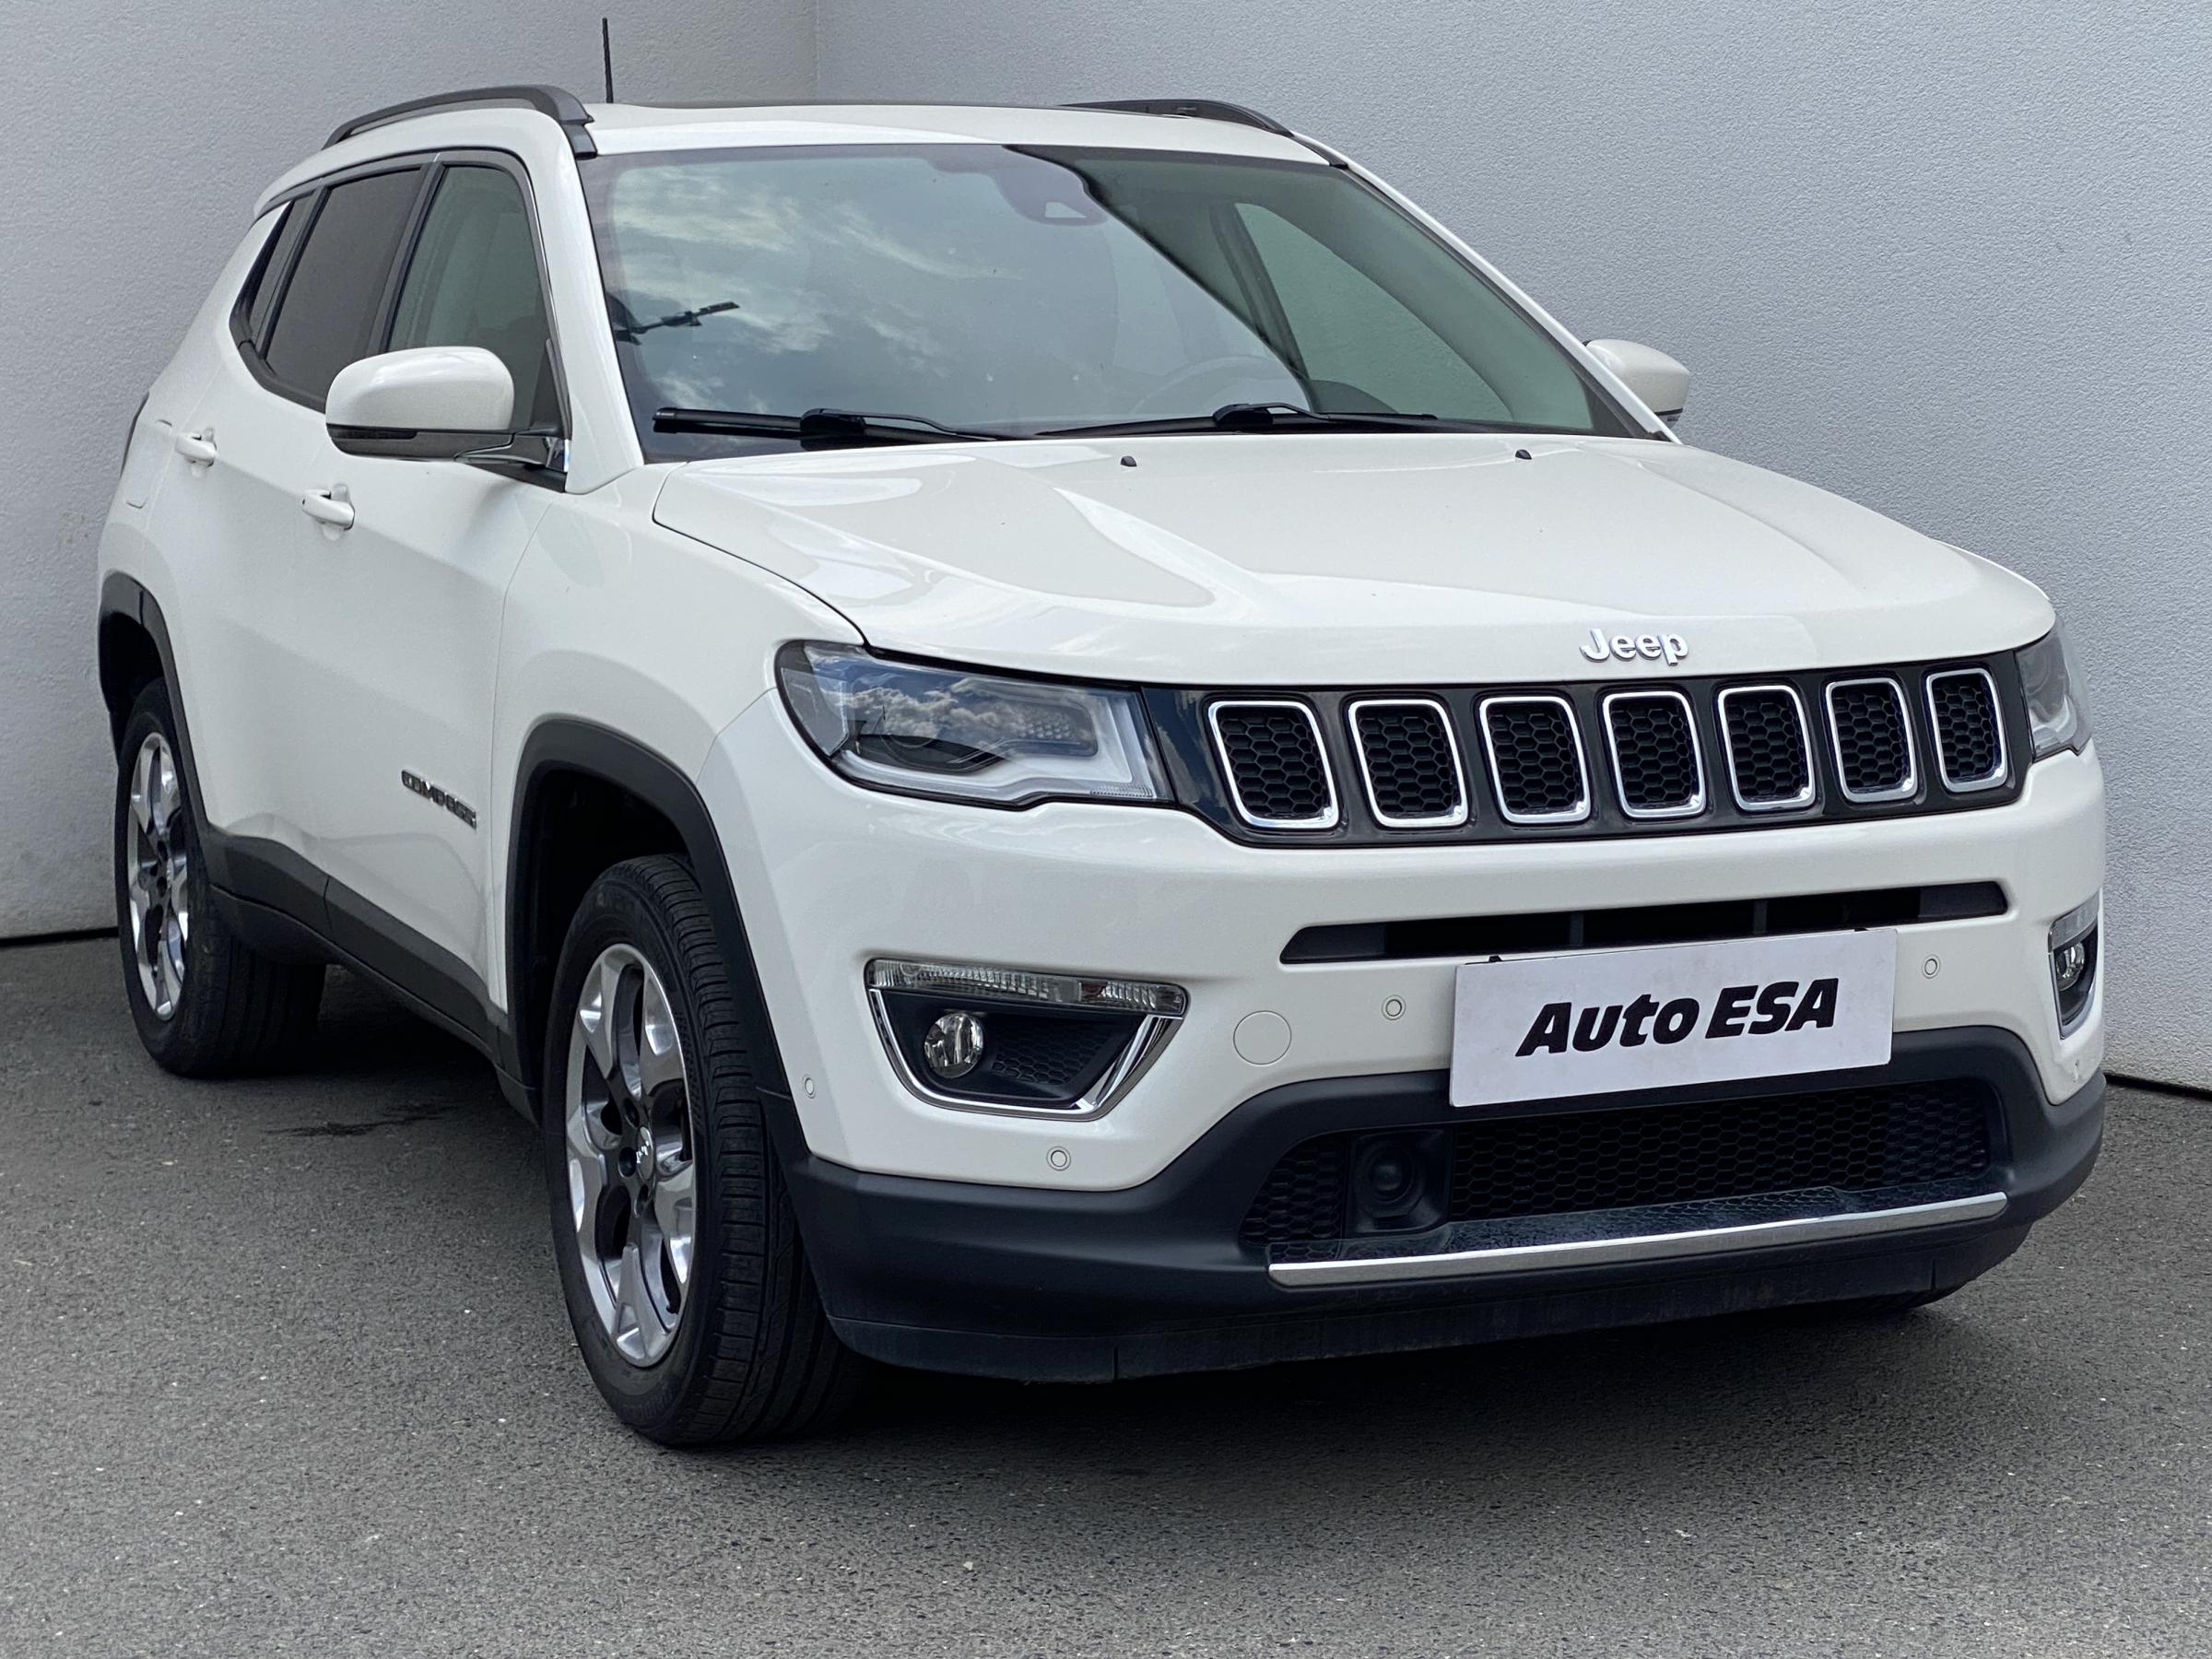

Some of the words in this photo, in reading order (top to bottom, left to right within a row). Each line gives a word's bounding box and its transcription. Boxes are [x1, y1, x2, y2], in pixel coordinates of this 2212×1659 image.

[1580, 629, 1688, 666] Jeep
[1515, 994, 1700, 1056] Auto
[1705, 978, 1839, 1039] ESA
